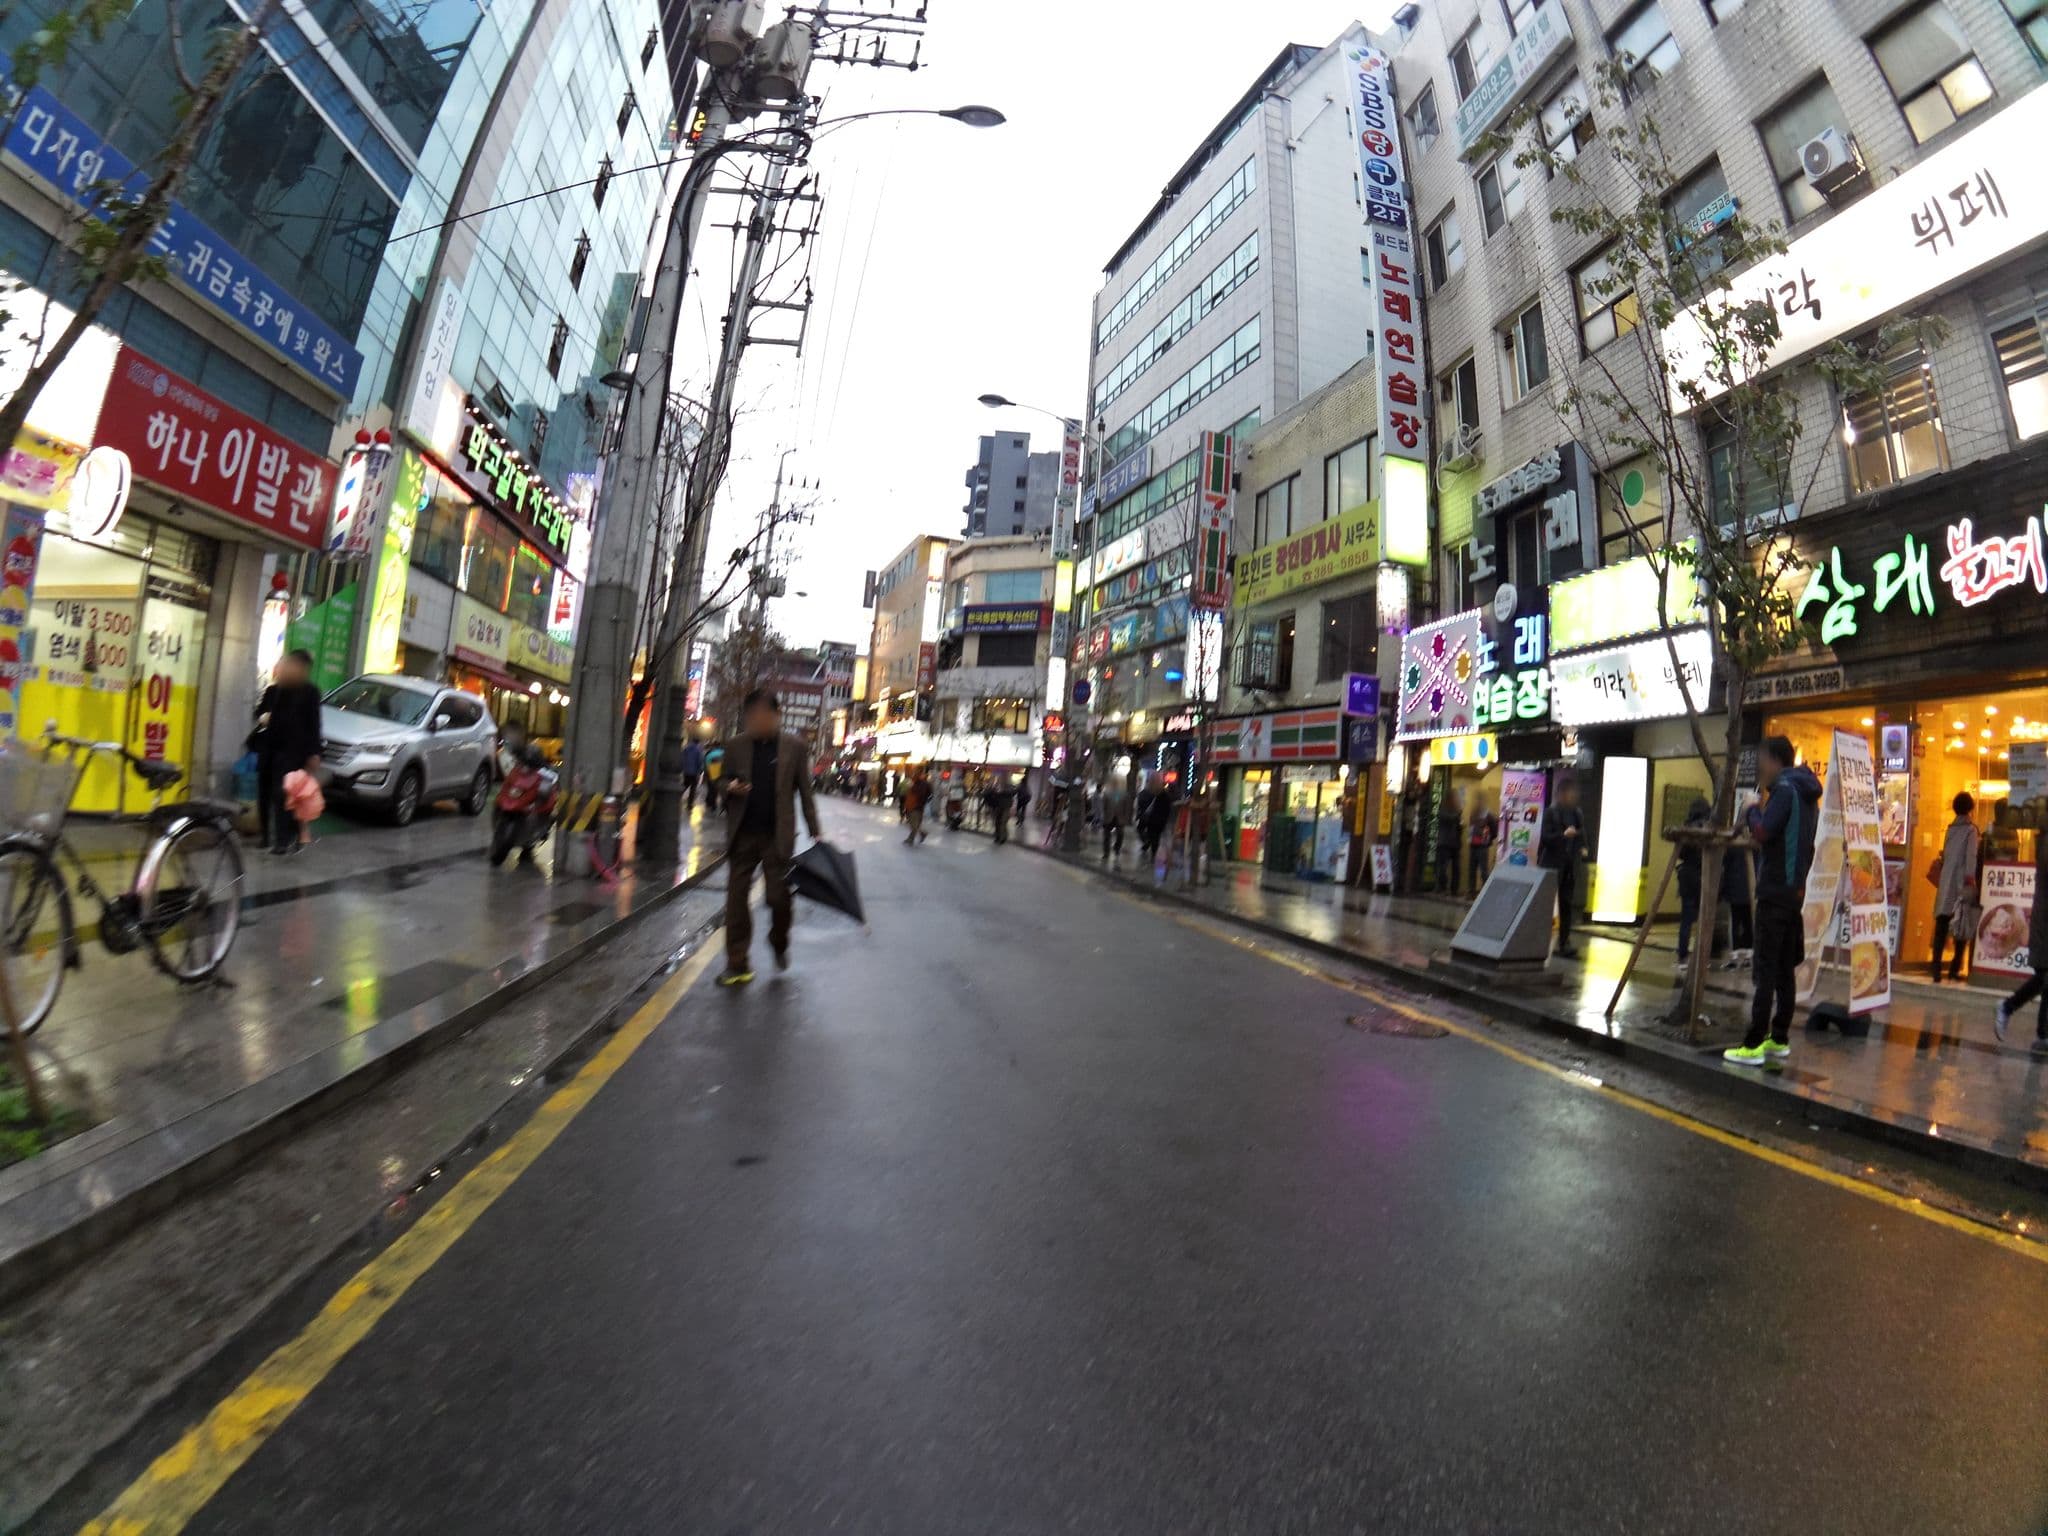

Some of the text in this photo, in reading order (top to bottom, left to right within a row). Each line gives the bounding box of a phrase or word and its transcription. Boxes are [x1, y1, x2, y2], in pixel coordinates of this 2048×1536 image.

[1358, 73, 1401, 223] SBS 당구 클럽 2F
[1911, 167, 2009, 256] 뷔페
[187, 240, 345, 384] 귀금속공예 및 왁스
[1374, 232, 1422, 450] 월드컵 노래연습장
[147, 410, 209, 485] 하나
[219, 427, 323, 534] 이발관
[1239, 550, 1273, 587] 포인트
[1344, 517, 1377, 547] 사무소
[1796, 532, 1936, 646] 삼대
[1940, 517, 2048, 608] 불고기
[1472, 667, 1552, 726] 연습장
